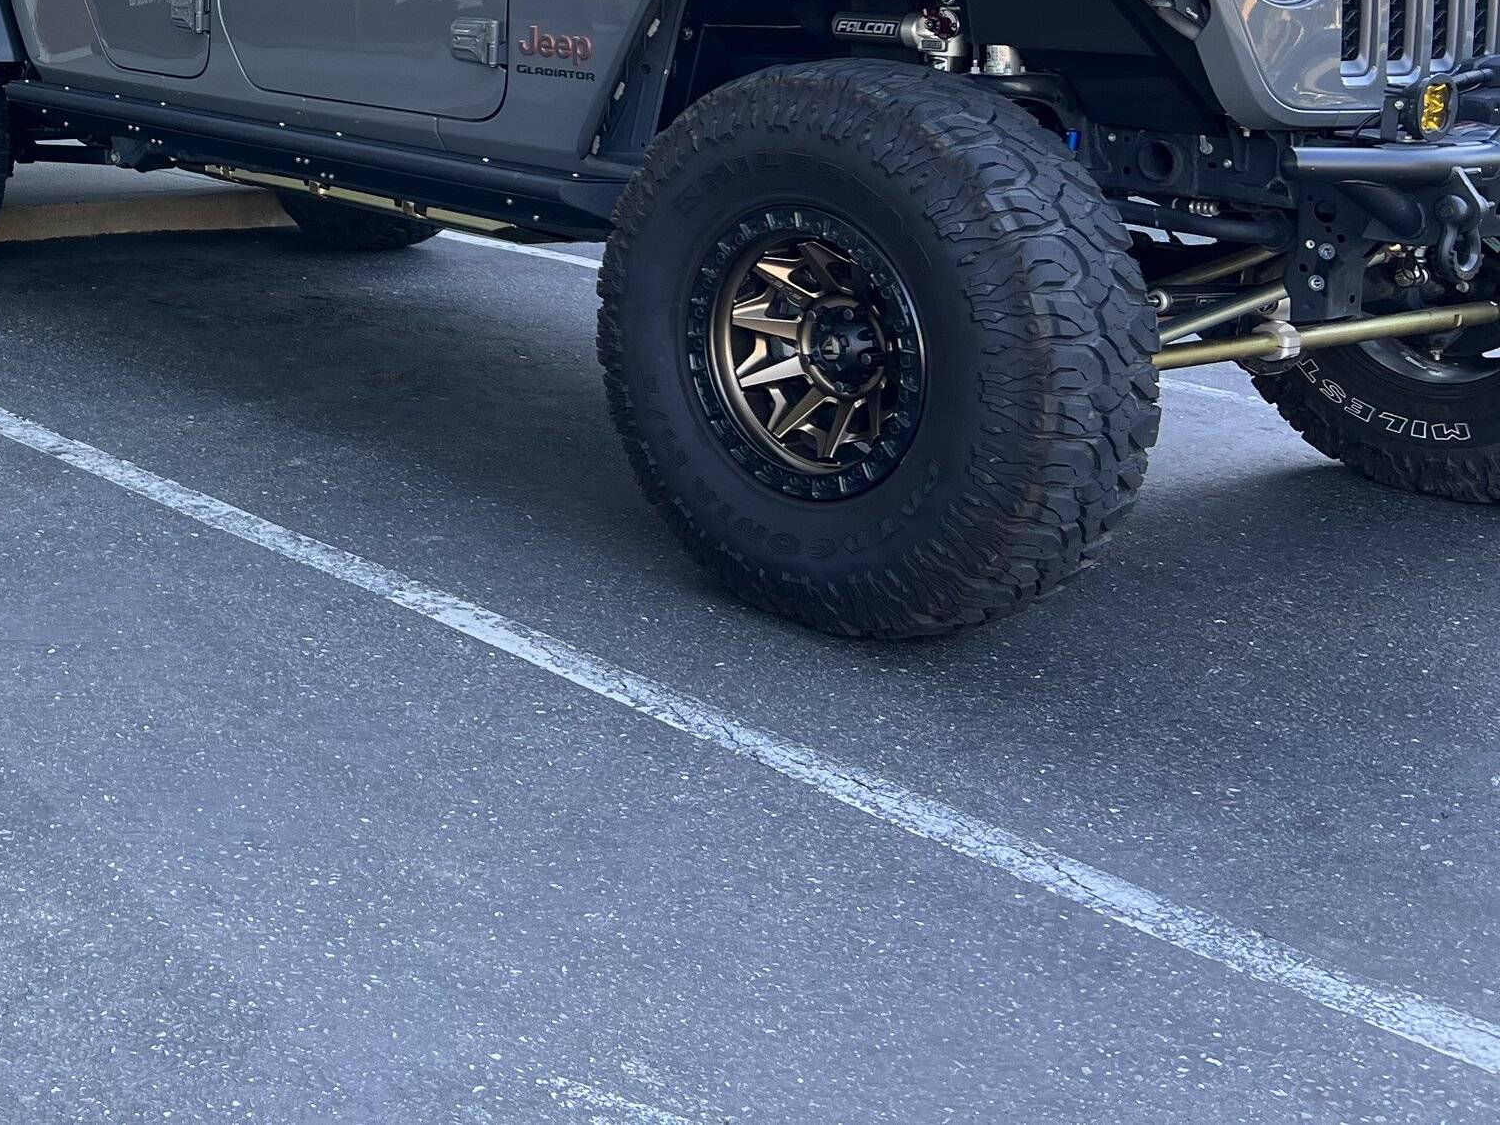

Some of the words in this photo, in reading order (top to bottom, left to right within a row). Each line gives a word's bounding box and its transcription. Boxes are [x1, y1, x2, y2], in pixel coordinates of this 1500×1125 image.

[836, 19, 896, 36] FALCON
[518, 24, 595, 67] Jeep
[516, 64, 597, 82] GLADIATOR
